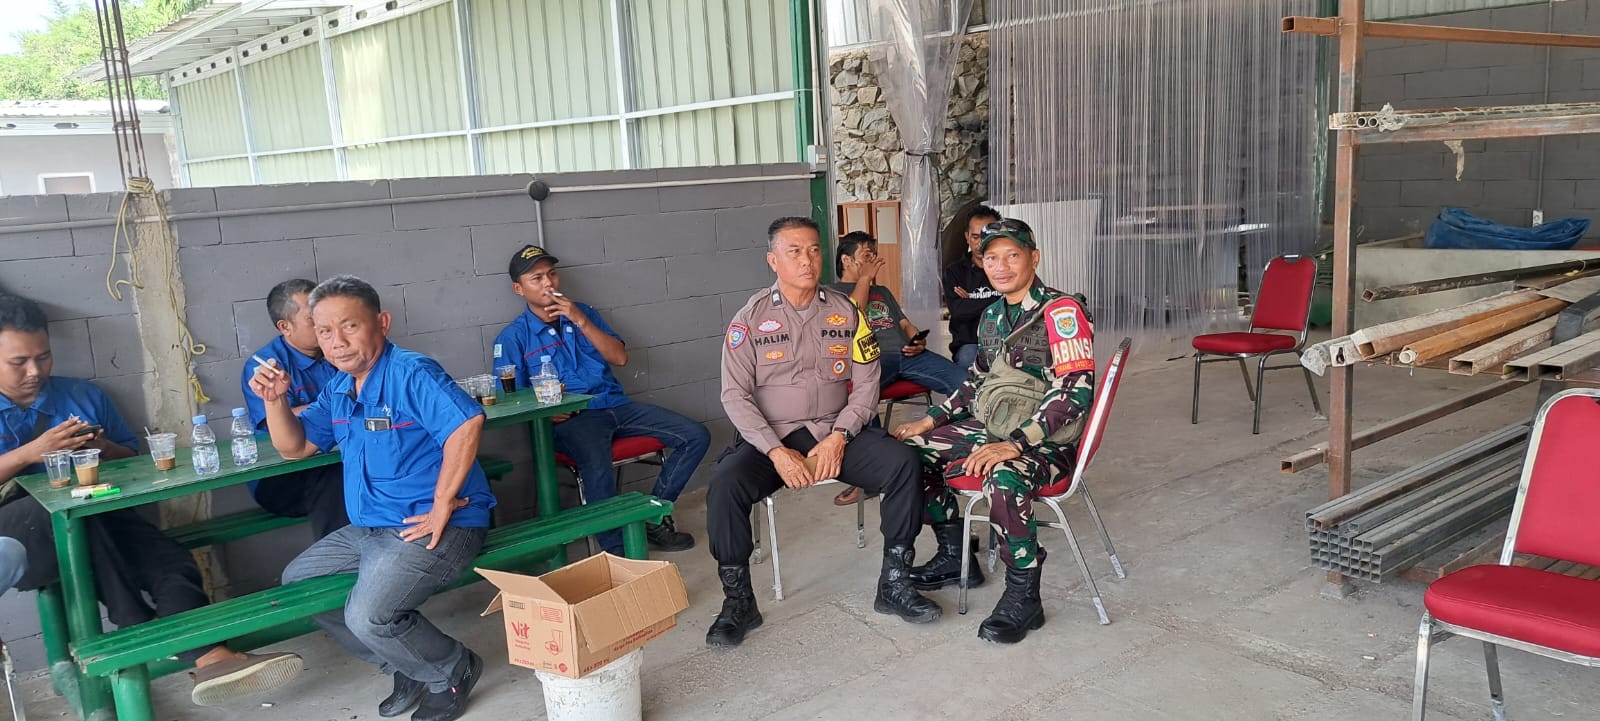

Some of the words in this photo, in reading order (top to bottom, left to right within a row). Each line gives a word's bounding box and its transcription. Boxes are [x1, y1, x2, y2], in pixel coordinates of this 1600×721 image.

[754, 333, 790, 346] HALIM
[821, 329, 856, 338] POLRI
[511, 620, 531, 639] Vit
